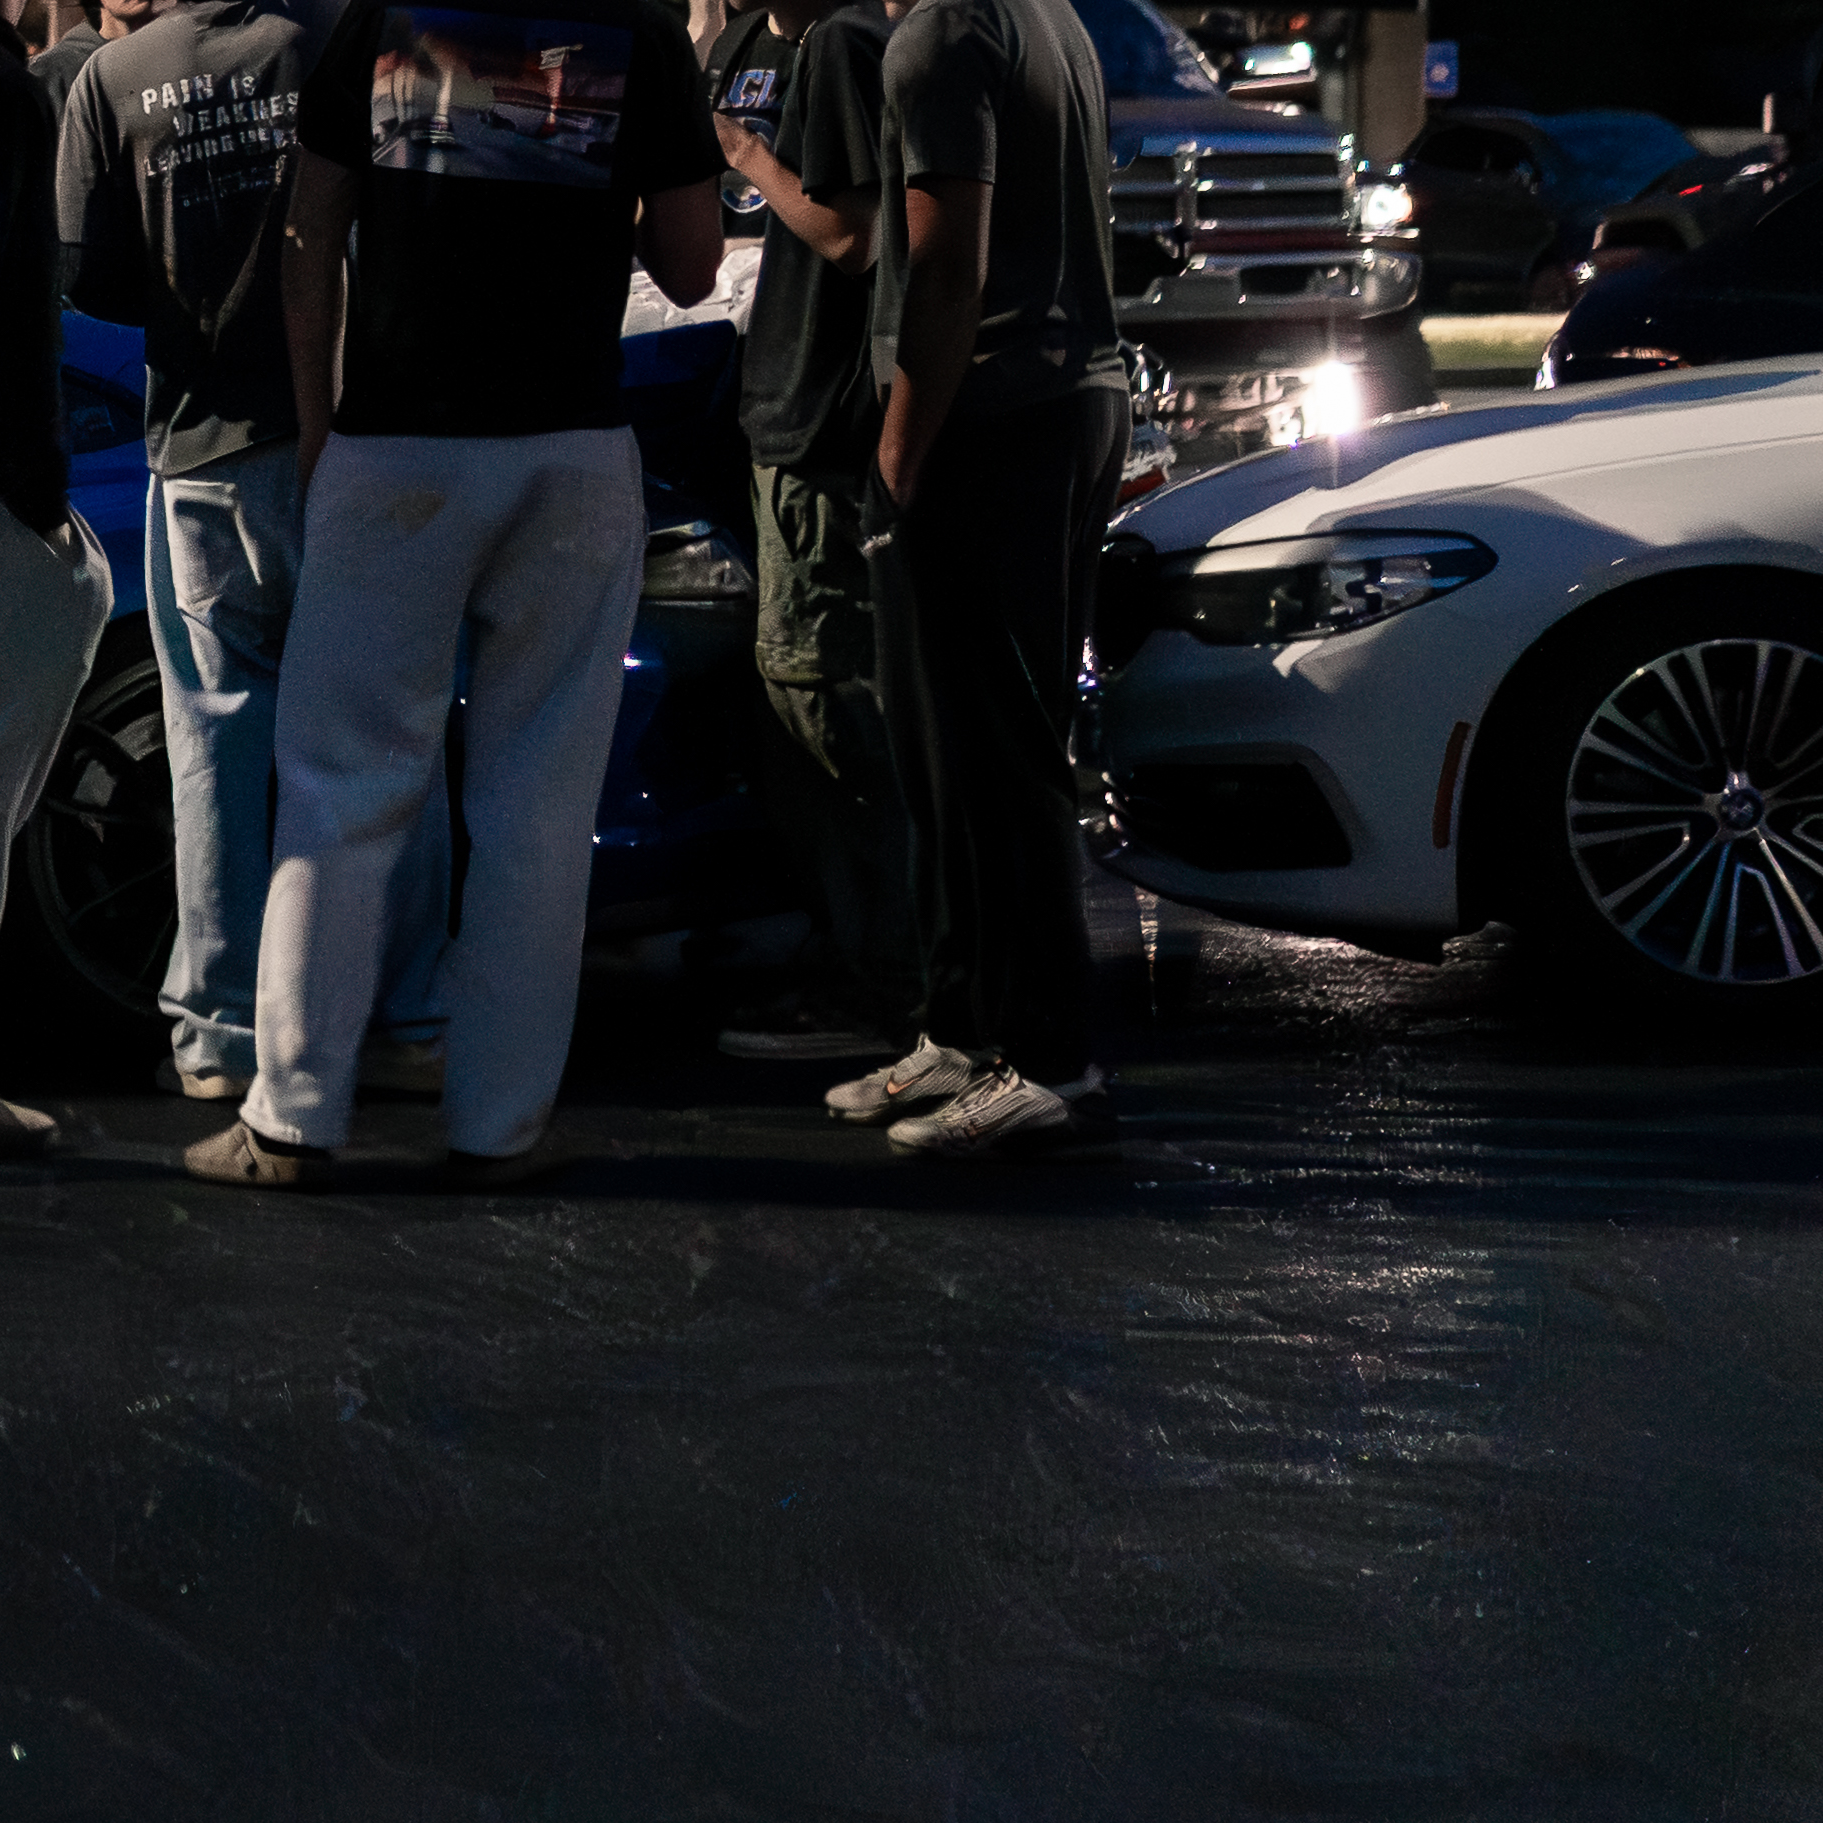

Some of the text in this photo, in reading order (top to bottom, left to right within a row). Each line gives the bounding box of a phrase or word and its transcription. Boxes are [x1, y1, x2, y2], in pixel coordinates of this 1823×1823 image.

[141, 74, 255, 114] PAIN IS
[172, 91, 300, 138] WEAKNES
